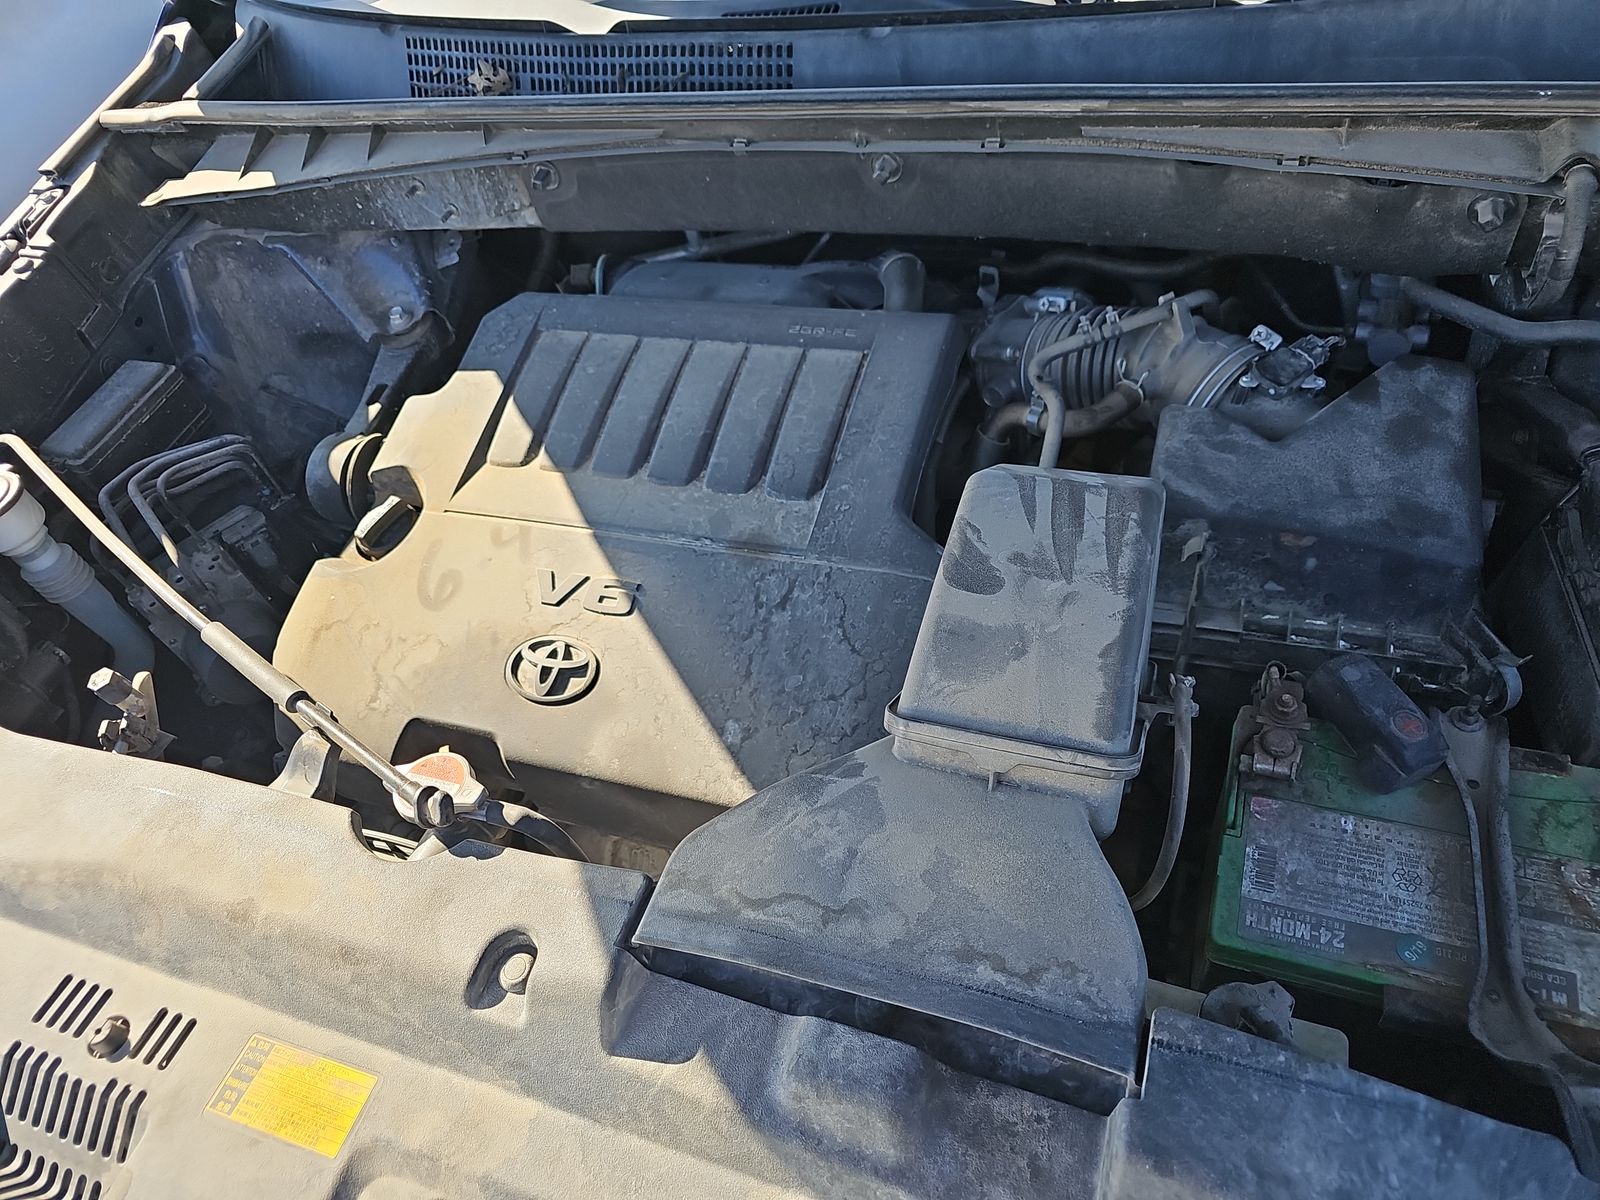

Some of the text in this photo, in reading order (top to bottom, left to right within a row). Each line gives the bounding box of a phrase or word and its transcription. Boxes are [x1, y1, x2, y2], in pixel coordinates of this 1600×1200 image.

[536, 567, 643, 618] V6
[1246, 908, 1346, 949] 24-MONTH
[1320, 917, 1346, 931] FREE
[1404, 940, 1427, 961] 9/19
